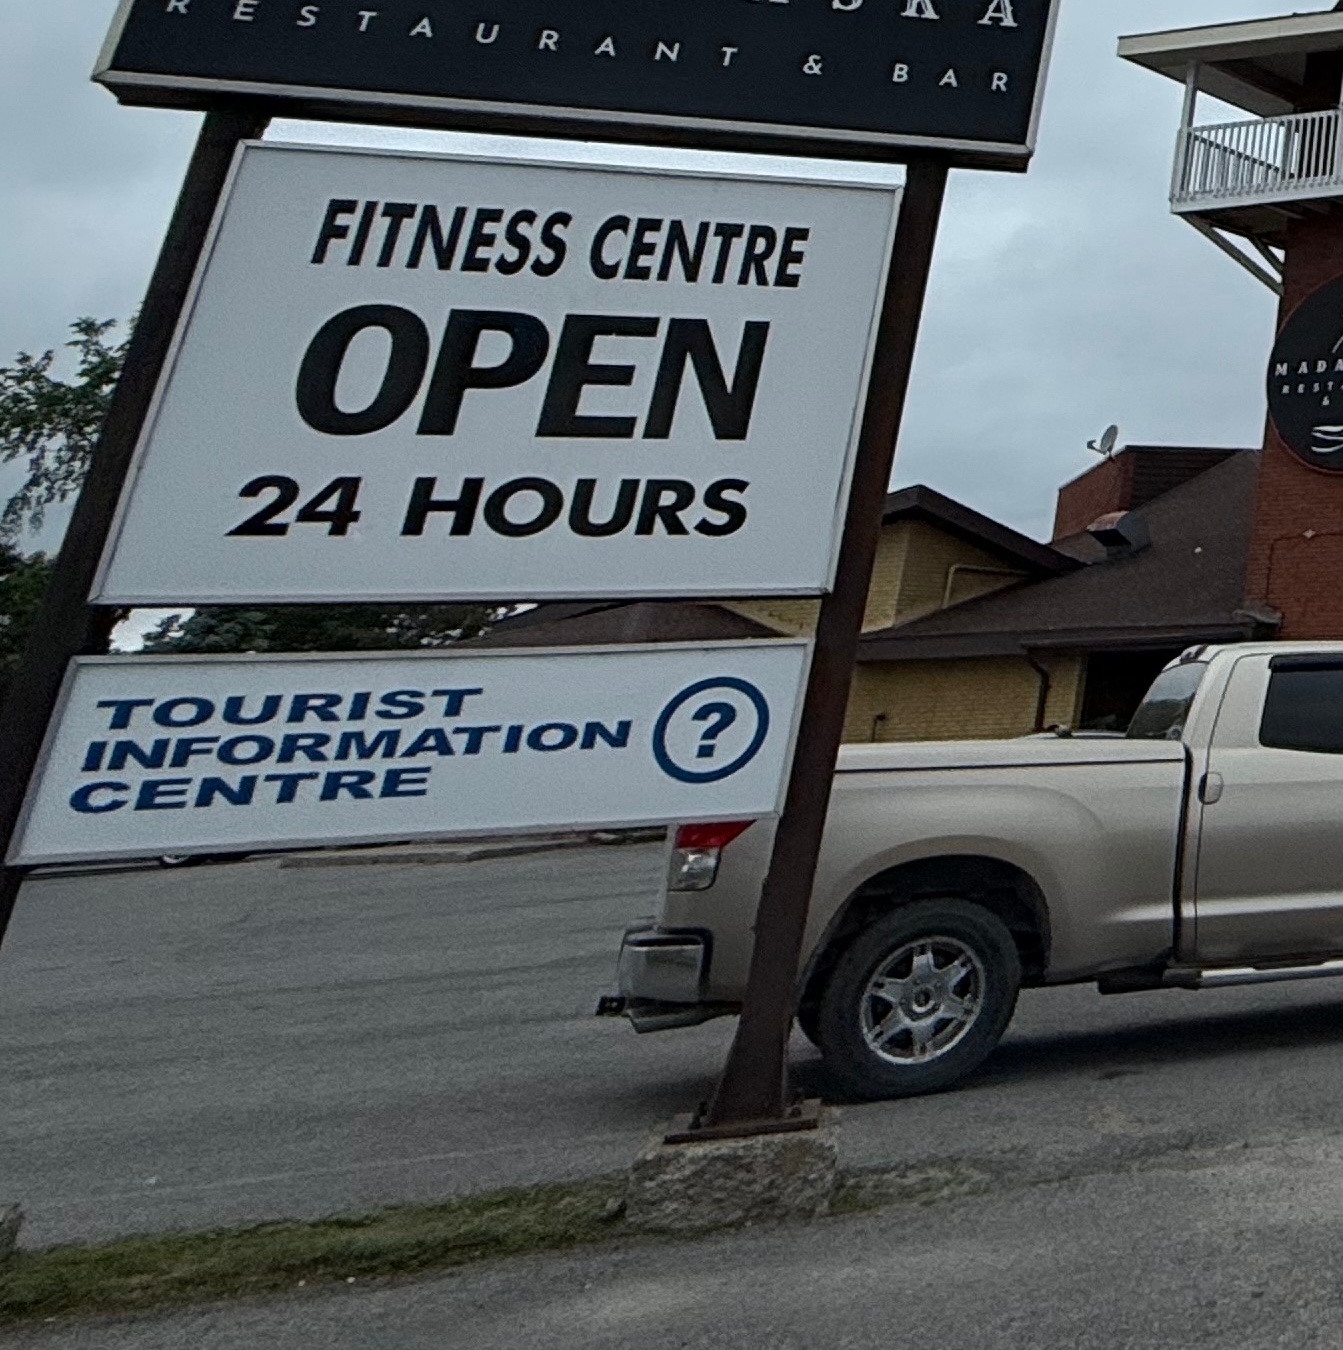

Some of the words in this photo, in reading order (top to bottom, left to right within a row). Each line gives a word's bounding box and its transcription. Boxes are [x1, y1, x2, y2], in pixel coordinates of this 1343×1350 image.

[802, 54, 822, 75] &
[892, 63, 1008, 91] BAR
[310, 198, 573, 278] FITNESS
[589, 214, 810, 288] CENTRE
[295, 303, 771, 441] OPEN
[224, 474, 362, 537] 24
[400, 476, 750, 538] HOURS
[96, 687, 484, 731] TOURIST
[80, 720, 633, 773] INFORMATION
[69, 766, 432, 814] CENTRE
